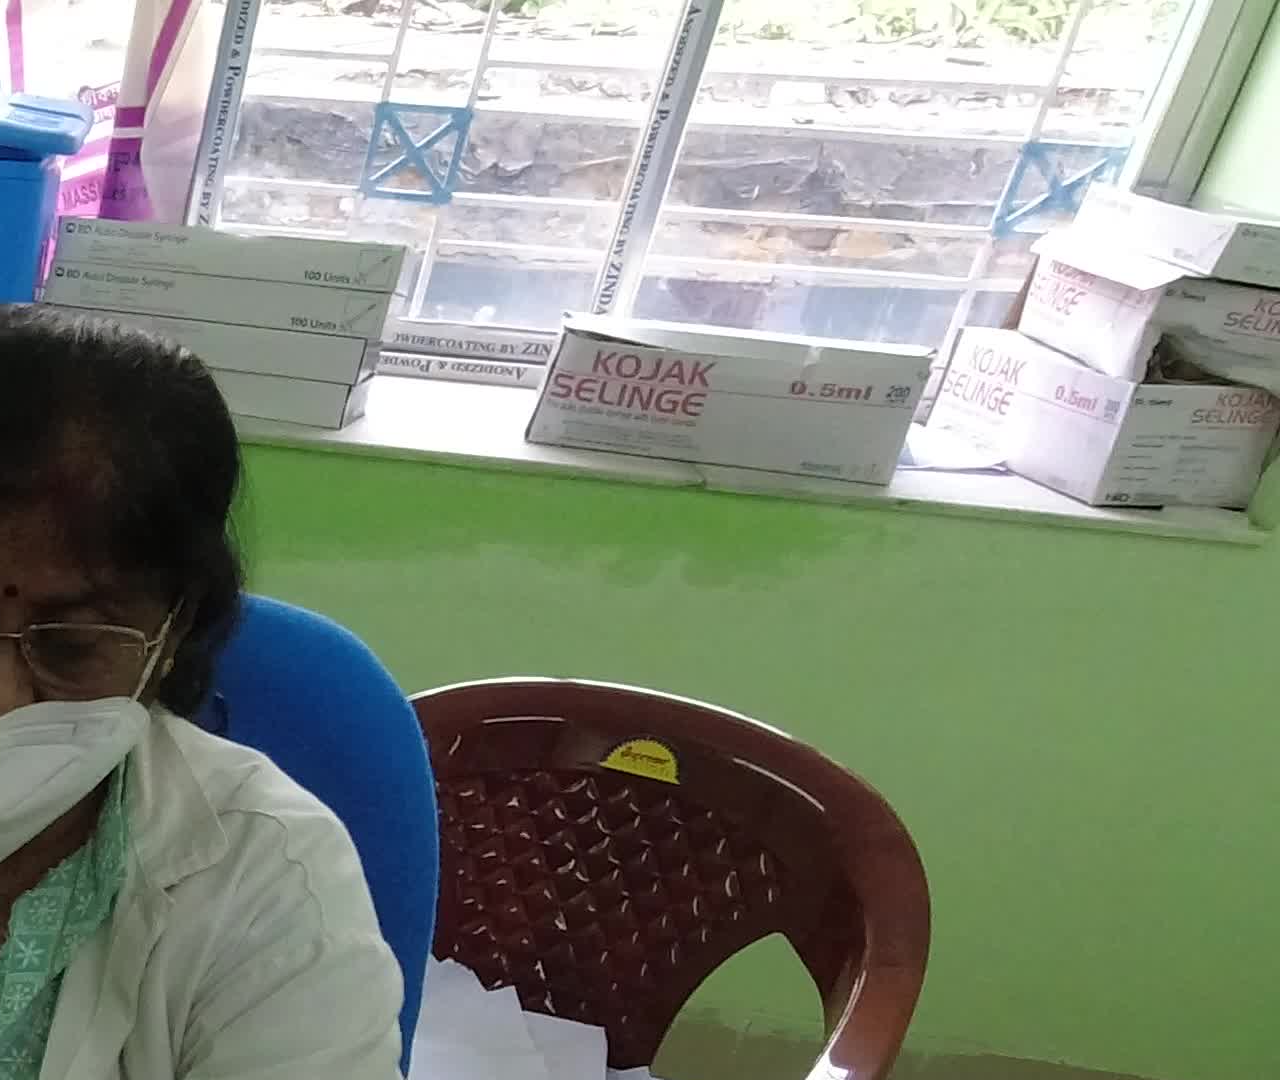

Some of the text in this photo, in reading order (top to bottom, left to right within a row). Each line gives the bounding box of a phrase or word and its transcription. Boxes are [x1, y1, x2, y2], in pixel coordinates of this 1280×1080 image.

[591, 350, 718, 388] KOJAK
[969, 344, 1028, 386] KOJAK
[550, 373, 707, 417] SELINGE
[789, 380, 873, 402] 0.5ml
[942, 370, 1015, 416] SELINGE
[1055, 385, 1098, 412] 0.5ml
